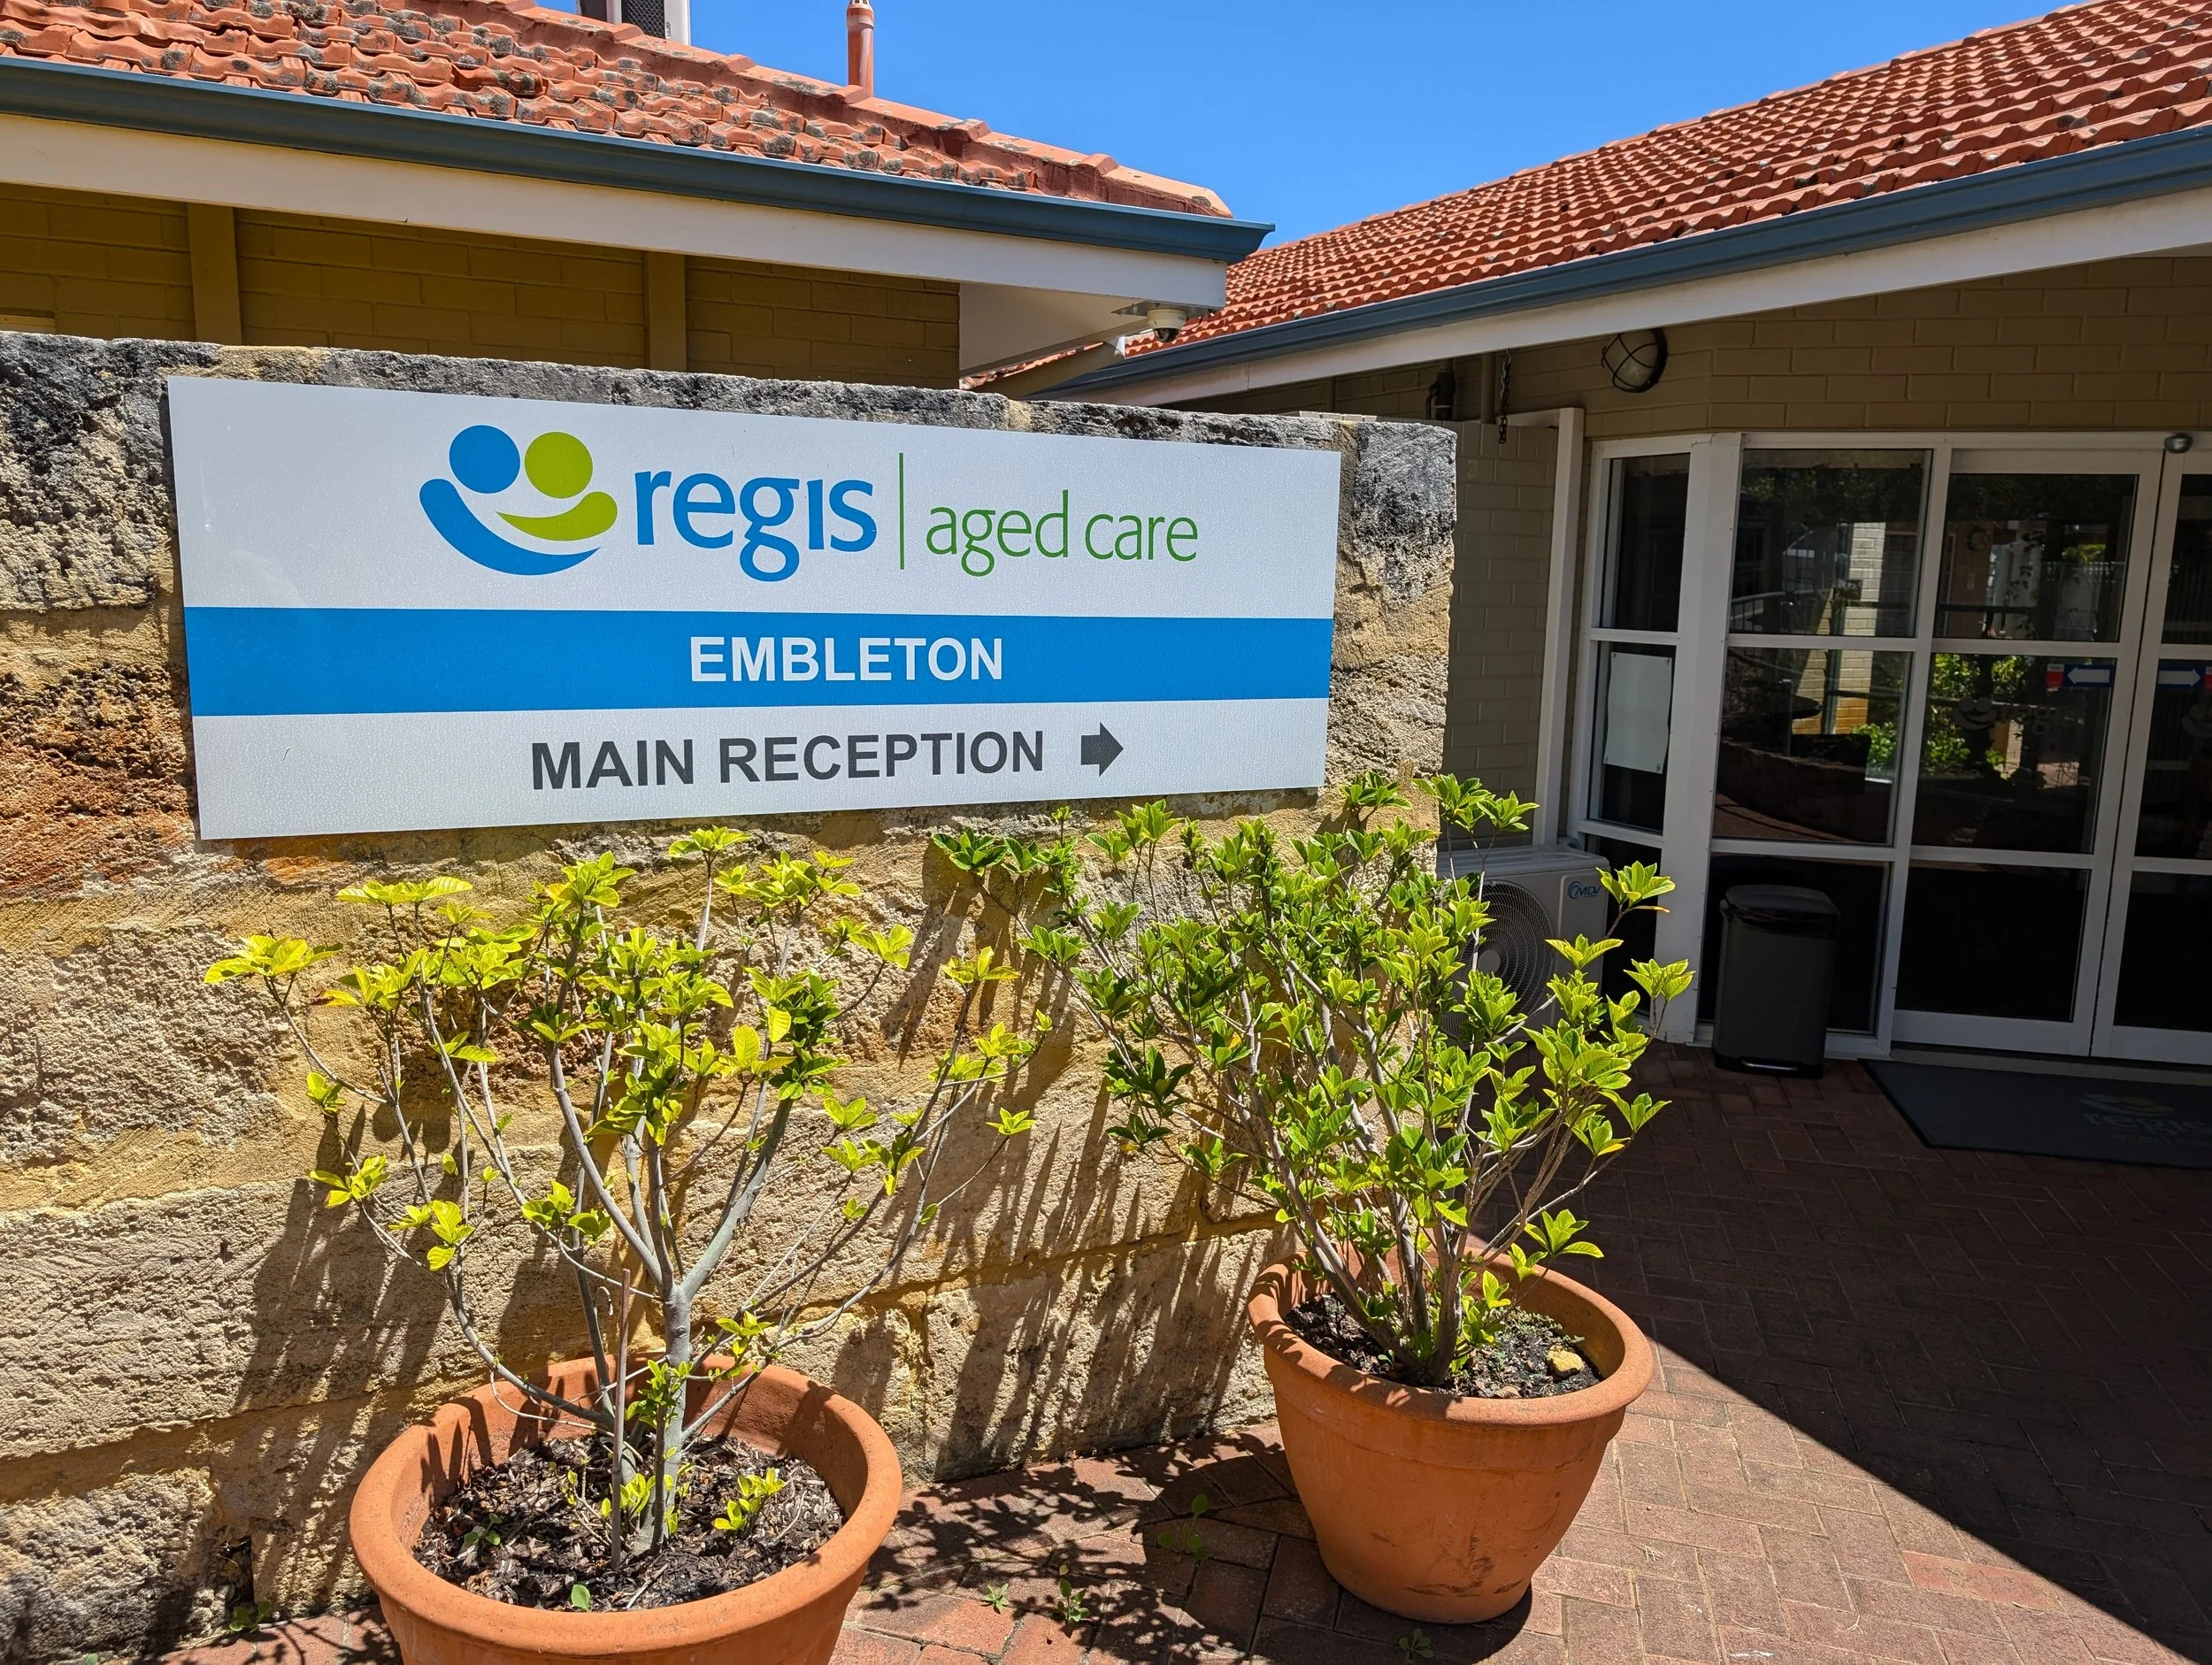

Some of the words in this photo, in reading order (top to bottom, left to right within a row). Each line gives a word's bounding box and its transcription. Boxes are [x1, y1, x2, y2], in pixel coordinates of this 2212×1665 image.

[634, 467, 879, 584] regis
[927, 490, 1069, 577] aged
[1086, 514, 1198, 562] care
[689, 635, 1004, 683] EMBLETON
[532, 738, 695, 791] MAIN
[719, 729, 1044, 783] RECEPTION
